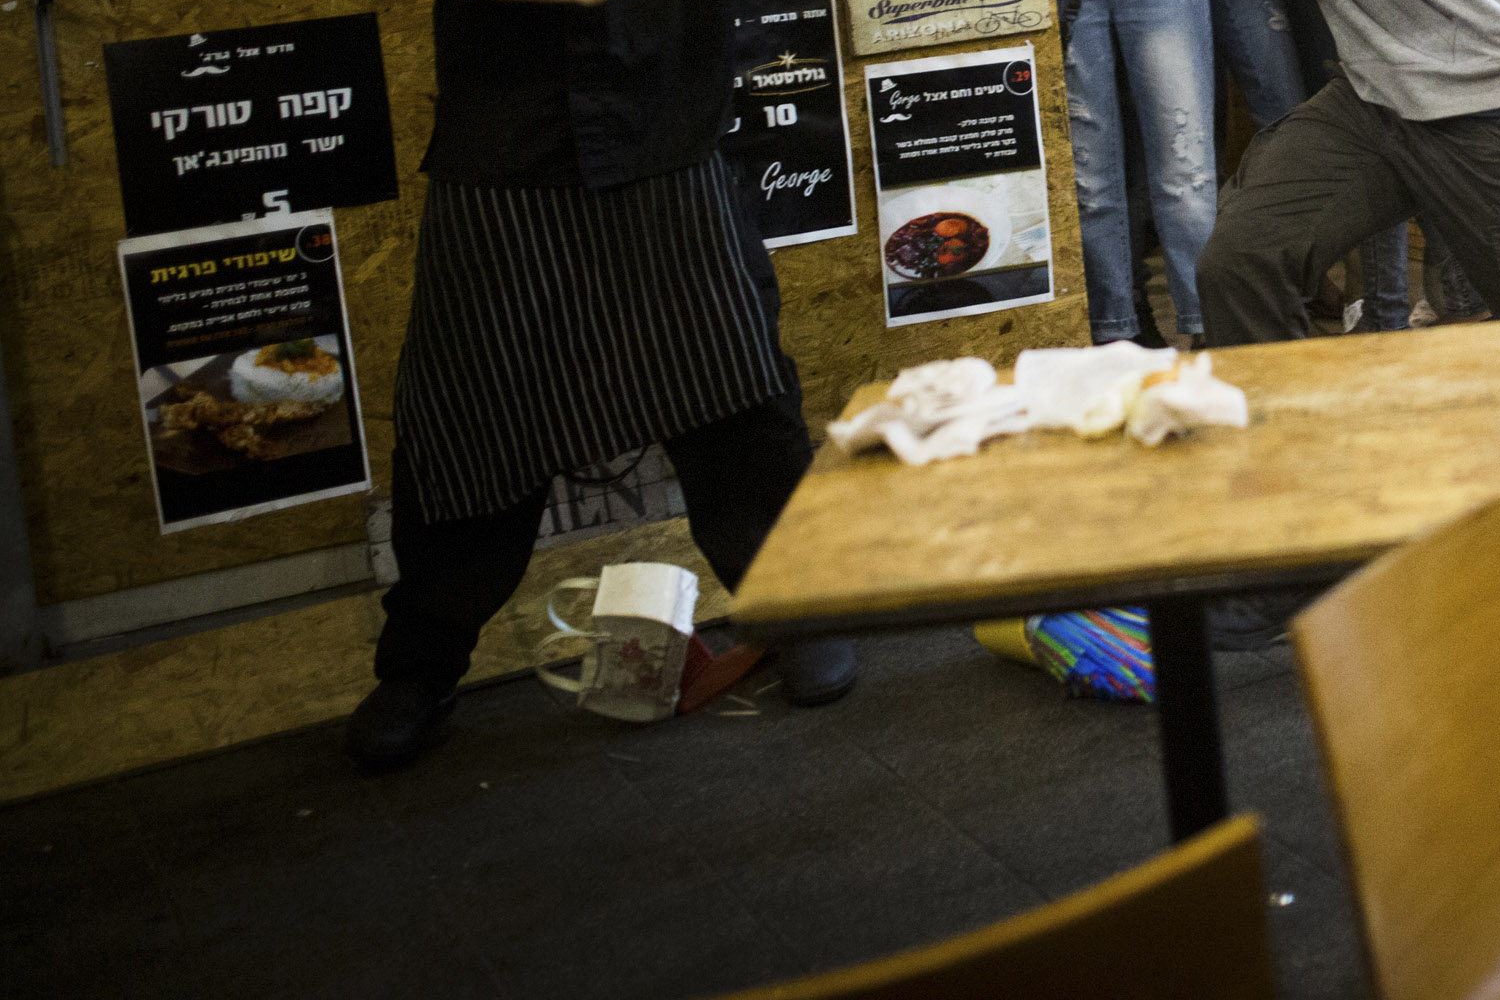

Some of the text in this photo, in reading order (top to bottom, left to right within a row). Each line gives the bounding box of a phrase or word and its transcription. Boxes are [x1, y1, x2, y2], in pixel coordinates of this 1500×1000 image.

[872, 14, 968, 44] ARIZONA
[752, 66, 827, 89] גולדסטאר
[922, 91, 949, 103] אצל
[150, 87, 353, 142] קפה טורקי
[763, 102, 799, 129] 10
[301, 134, 346, 154] ישר
[760, 161, 834, 201] George
[150, 247, 297, 284] שיפודי פרגית
